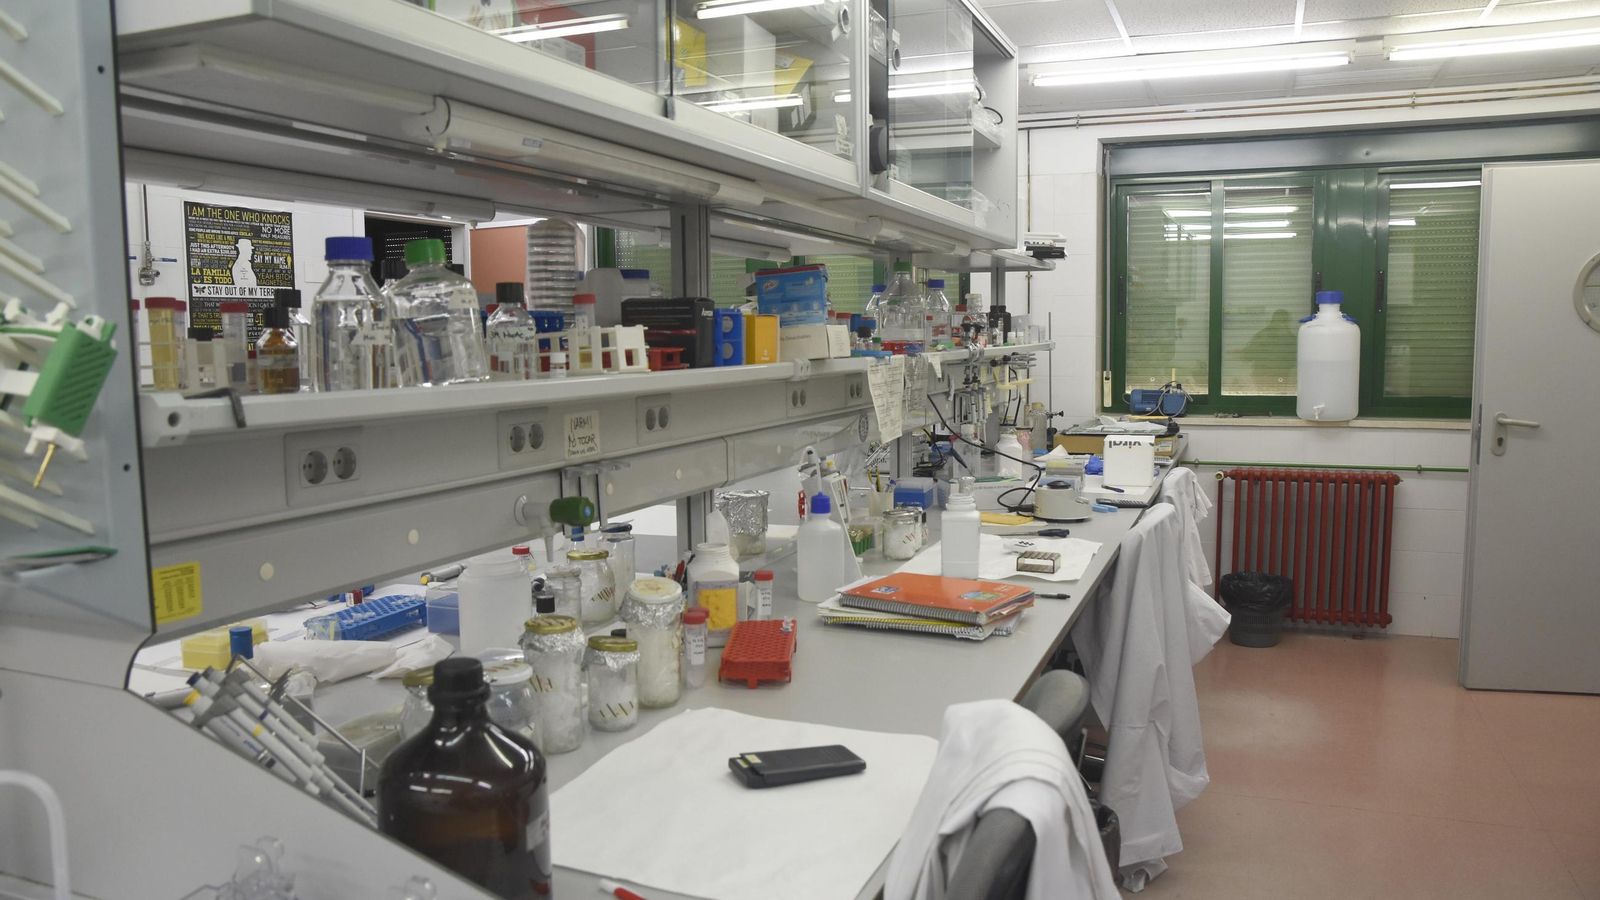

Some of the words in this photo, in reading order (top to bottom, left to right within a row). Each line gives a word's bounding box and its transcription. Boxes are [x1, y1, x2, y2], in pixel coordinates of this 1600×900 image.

[192, 207, 204, 218] AM
[207, 208, 222, 219] THE
[224, 210, 240, 220] ONE
[241, 211, 260, 222] WHO
[262, 212, 290, 225] KNOCKS
[274, 227, 290, 236] MORE
[254, 255, 262, 263] SAY
[208, 286, 222, 295] STAY
[225, 287, 236, 296] OUT
[239, 287, 247, 296] OF
[249, 288, 258, 296] MY
